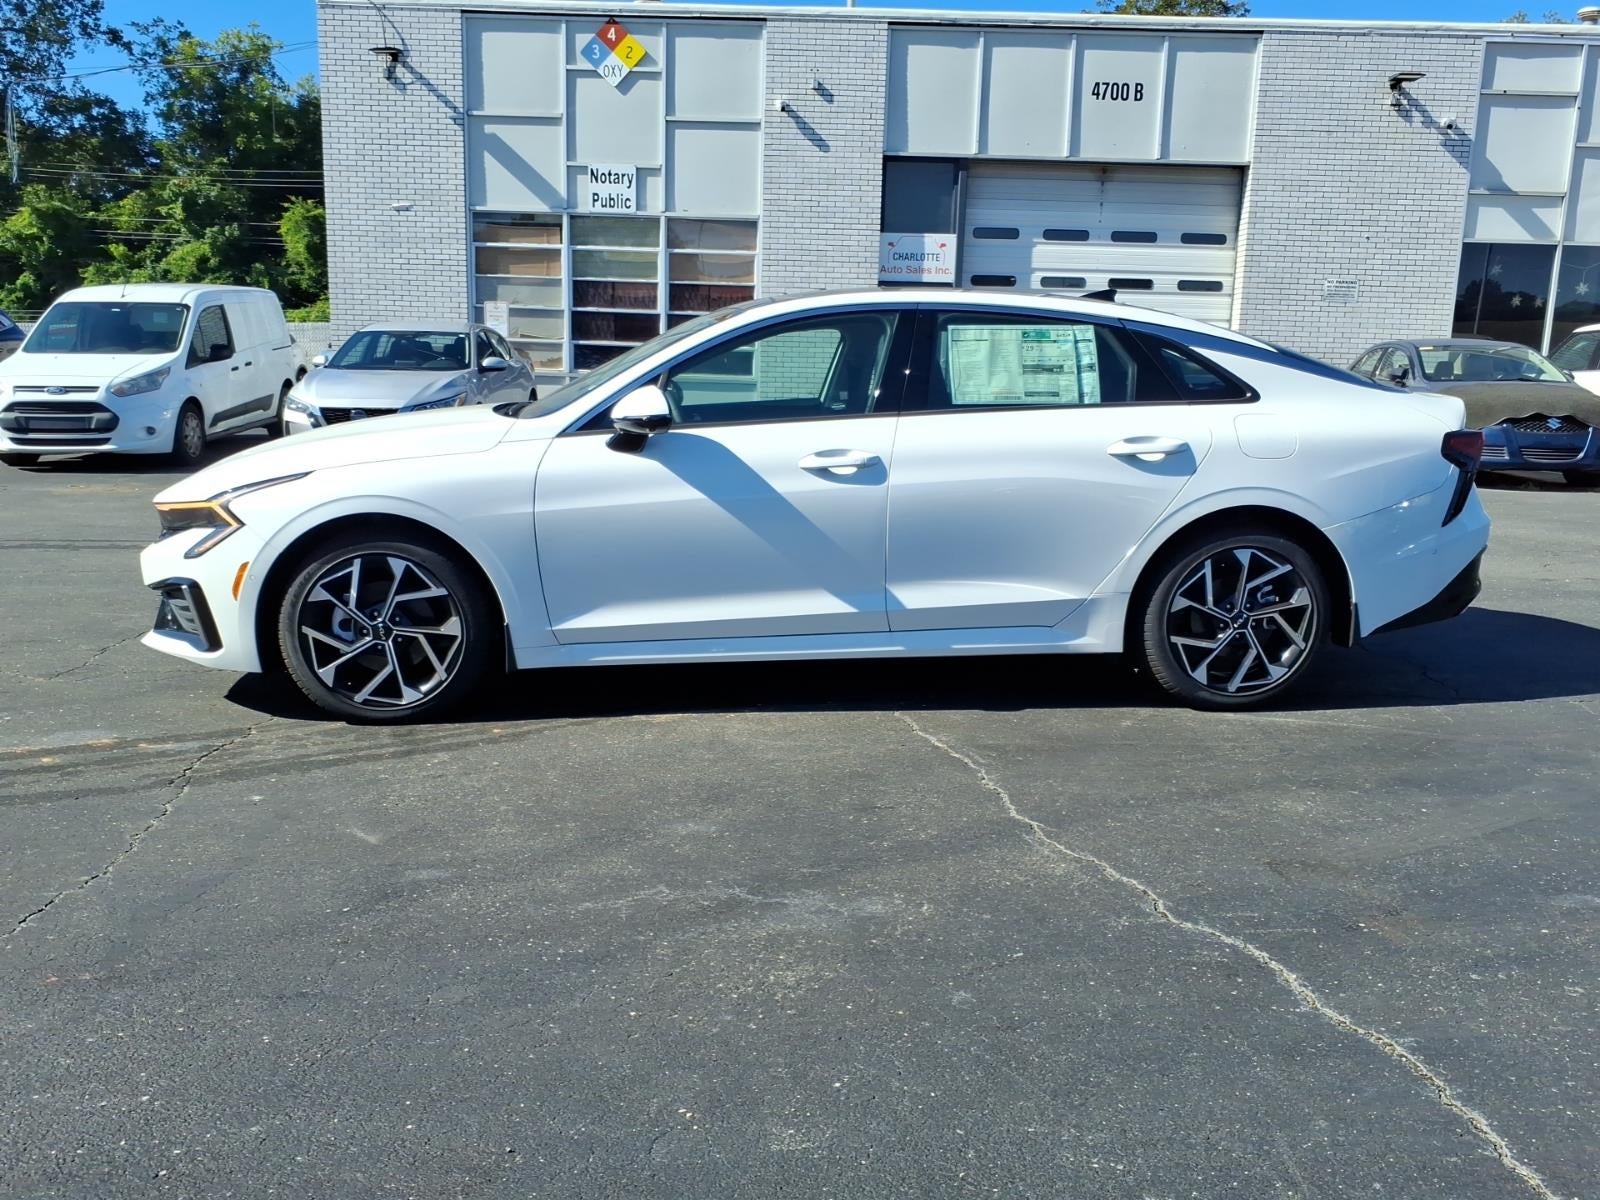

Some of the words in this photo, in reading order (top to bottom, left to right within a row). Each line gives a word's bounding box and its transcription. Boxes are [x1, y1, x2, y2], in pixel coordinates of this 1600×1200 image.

[607, 27, 616, 42] 4
[592, 45, 600, 59] 3
[625, 46, 633, 59] 2
[603, 64, 624, 78] OXY
[1091, 81, 1130, 101] 4700
[1134, 82, 1144, 102] B
[590, 167, 634, 189] Notary
[592, 192, 632, 209] Public
[892, 252, 940, 262] CHARLOTTE
[880, 265, 903, 274] Auto
[905, 265, 932, 275] Sales
[935, 266, 953, 275] Inc.
